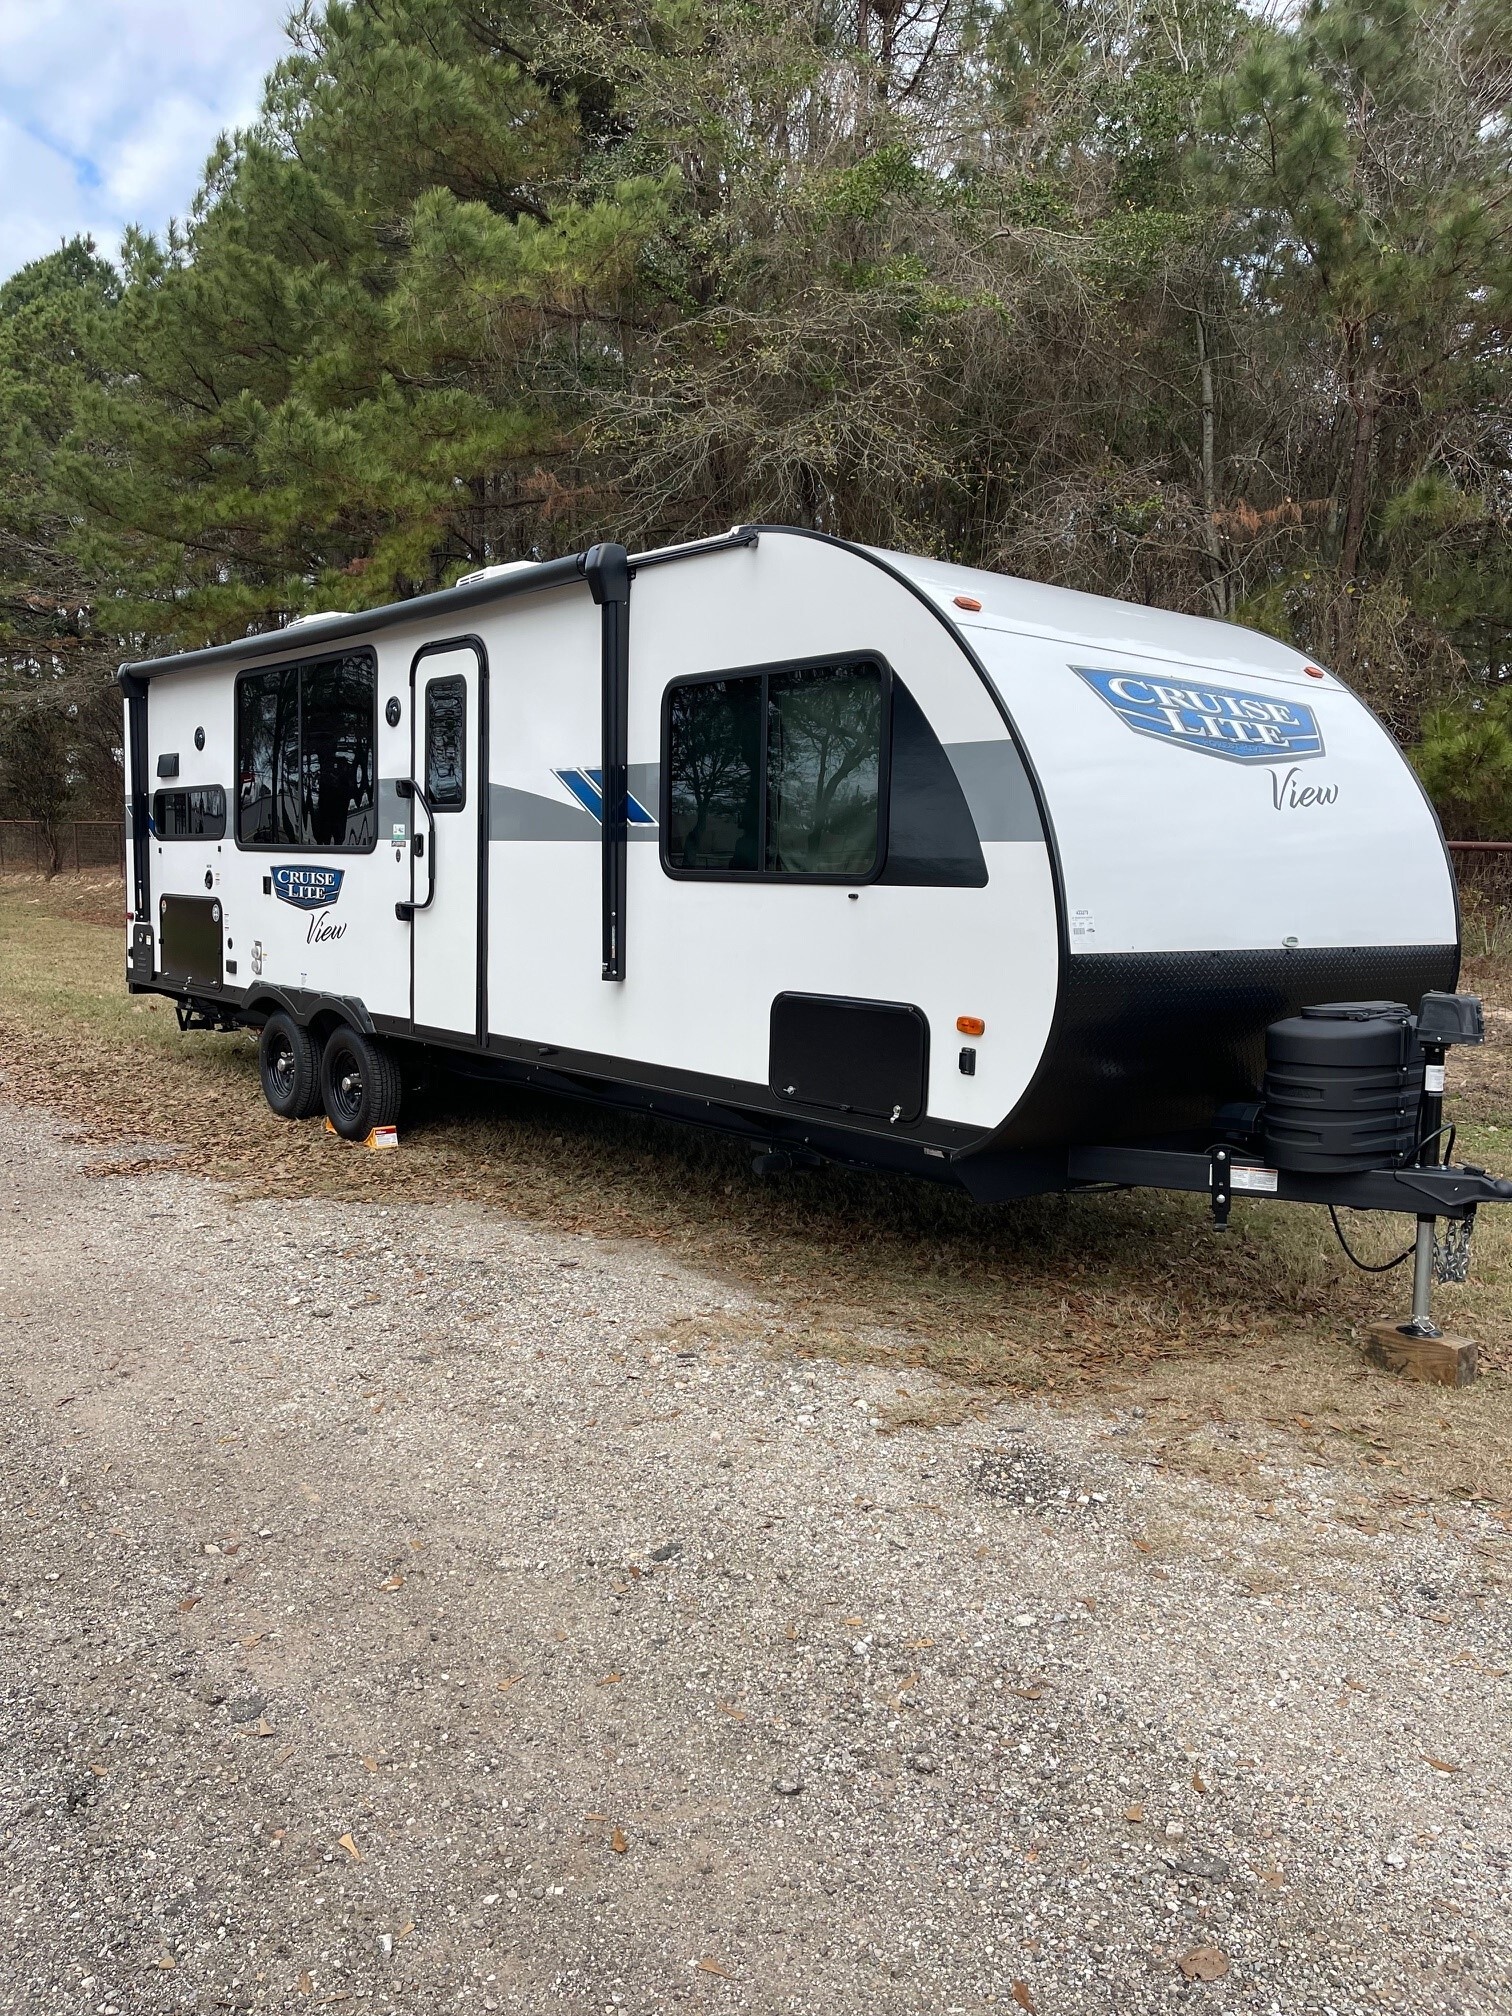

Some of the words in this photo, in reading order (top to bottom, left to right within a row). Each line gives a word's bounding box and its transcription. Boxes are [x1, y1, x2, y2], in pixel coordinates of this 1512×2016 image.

[1108, 677, 1300, 726] CRUISE
[1157, 707, 1290, 748] LITE
[1265, 767, 1339, 811] View
[277, 869, 335, 886] CRUISE
[287, 883, 326, 900] LITE
[306, 910, 347, 944] View
